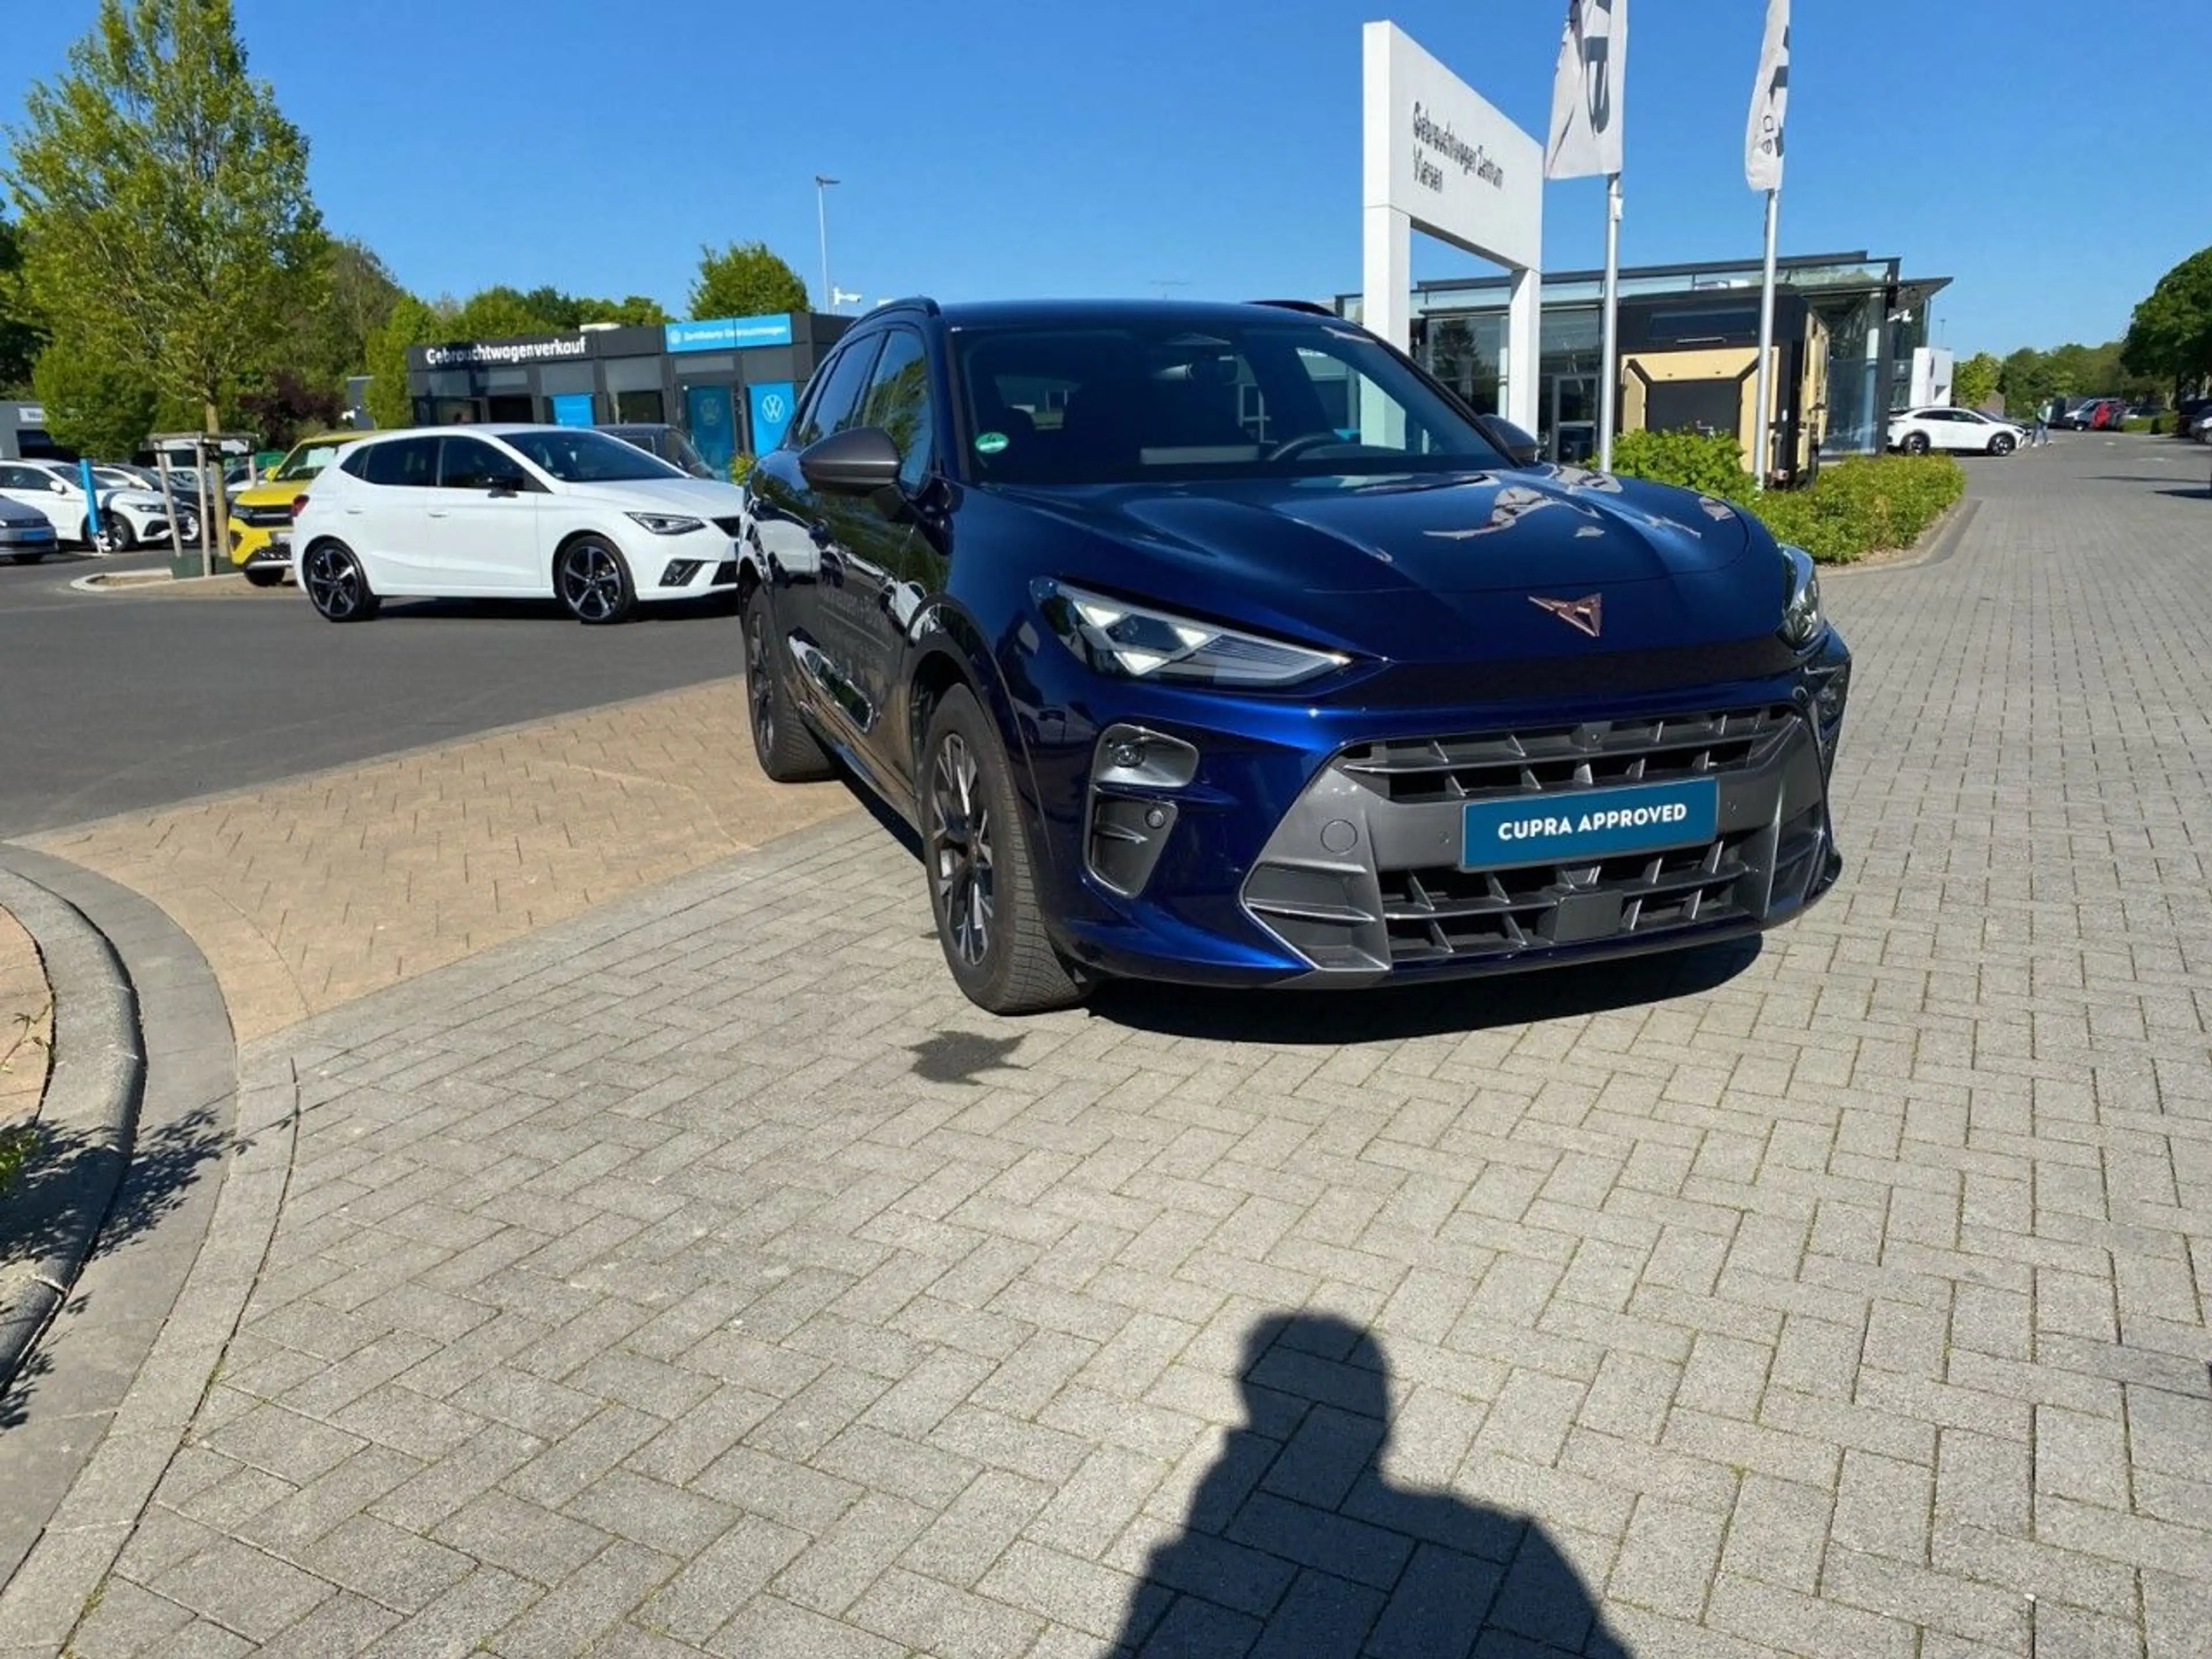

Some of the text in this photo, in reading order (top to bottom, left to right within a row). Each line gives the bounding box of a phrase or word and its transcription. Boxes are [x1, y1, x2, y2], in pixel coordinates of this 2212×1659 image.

[426, 335, 586, 364] Gebrauchtwagenverkauf
[1498, 802, 1687, 841] CUPRA APPROVED
